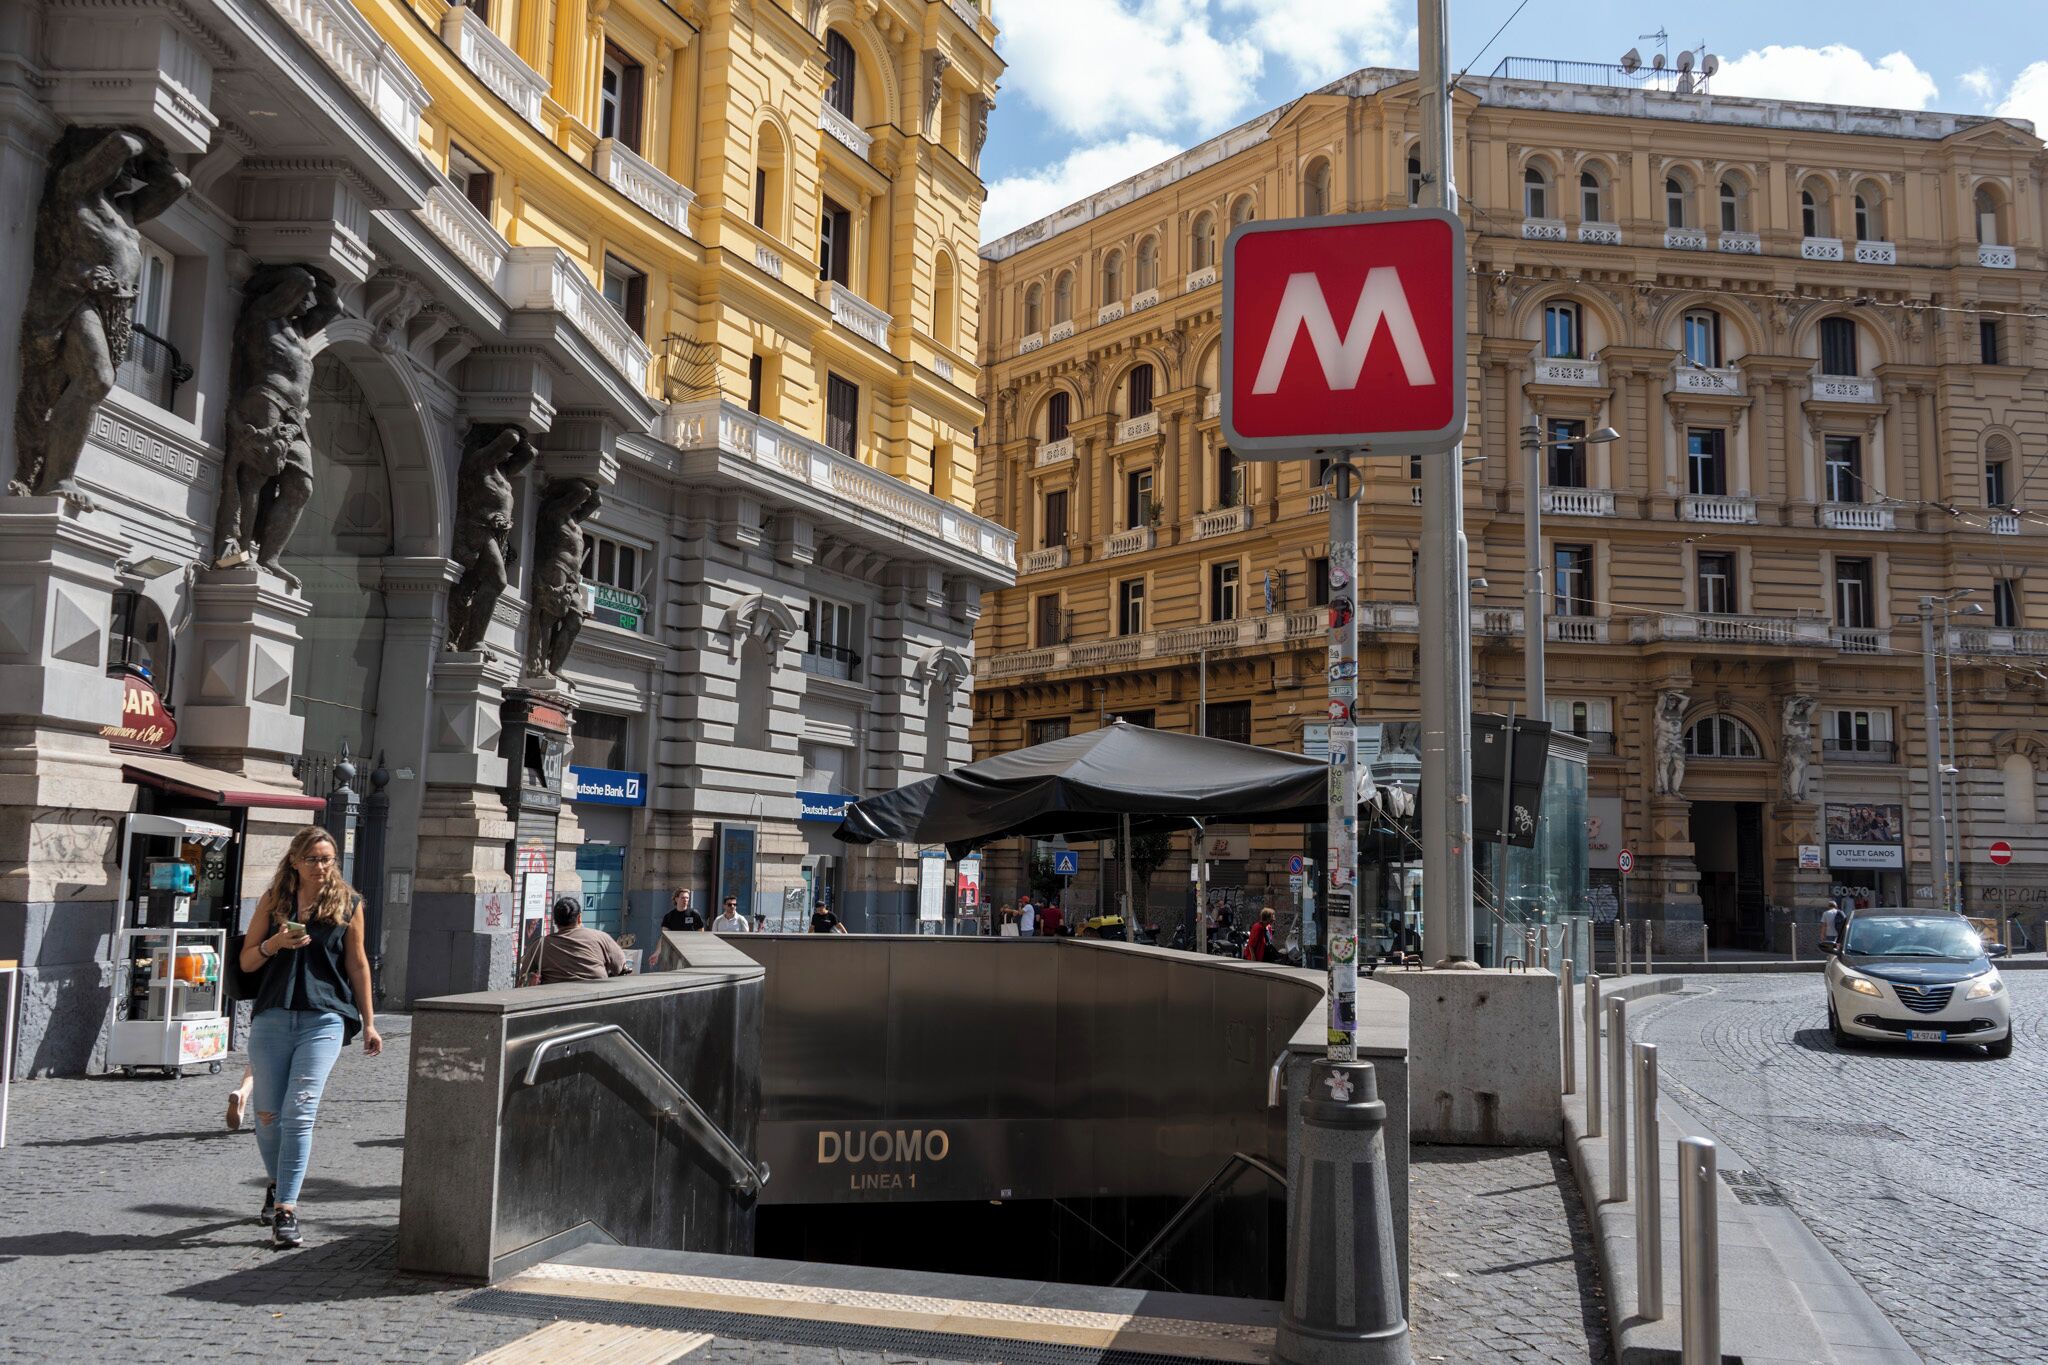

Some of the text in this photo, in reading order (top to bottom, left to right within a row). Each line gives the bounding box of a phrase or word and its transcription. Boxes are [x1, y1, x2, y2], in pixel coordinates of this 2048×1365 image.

[1251, 266, 1437, 395] M
[123, 688, 155, 716] AR
[576, 783, 624, 798] utsche Bank
[802, 804, 828, 815] Deutsche
[1836, 849, 1865, 857] OUTLET
[1621, 856, 1630, 867] 30
[818, 1129, 949, 1164] DUOMO
[851, 1173, 916, 1190] LINEA 1
